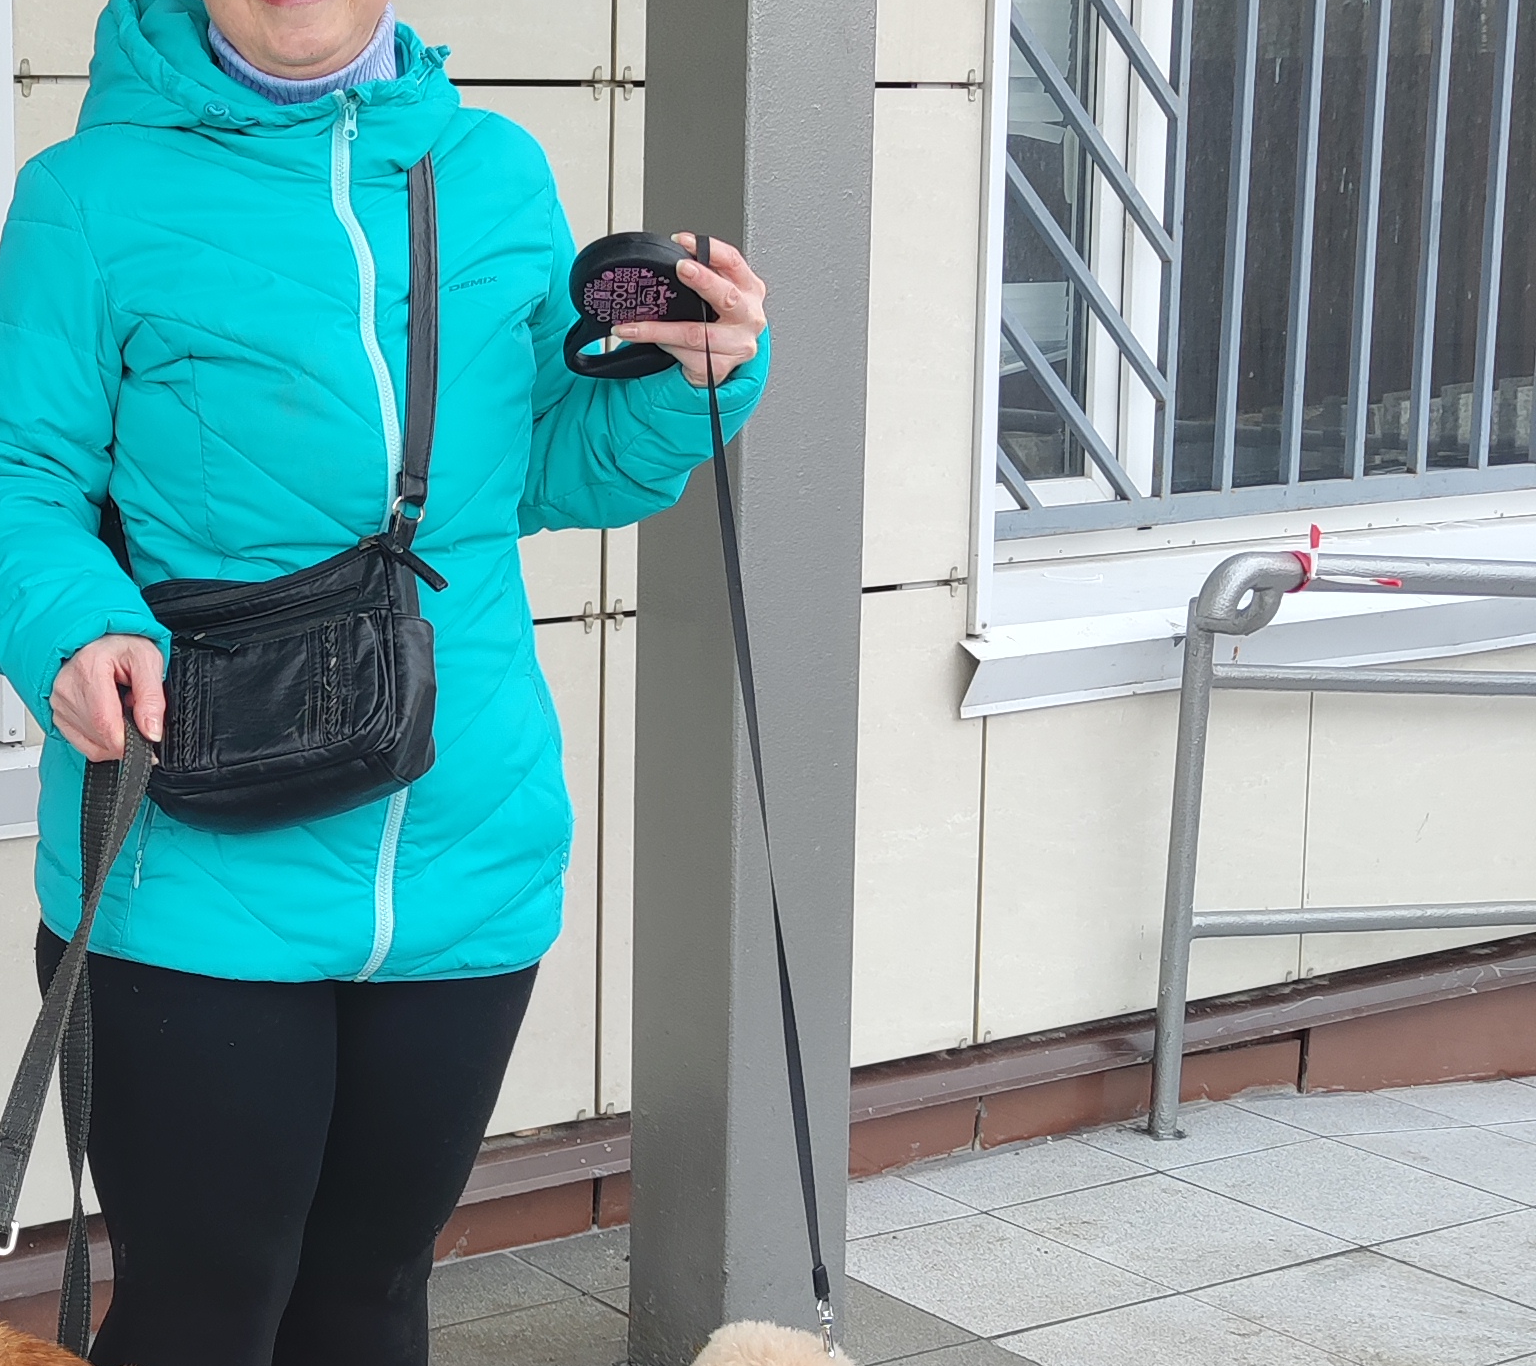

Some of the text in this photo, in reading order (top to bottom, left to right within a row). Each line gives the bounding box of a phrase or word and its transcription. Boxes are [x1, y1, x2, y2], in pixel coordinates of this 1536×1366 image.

[623, 268, 631, 282] DOG
[631, 268, 639, 282] DOG
[449, 276, 498, 292] DEMIX
[584, 288, 594, 305] DOG
[613, 283, 627, 309] DOG
